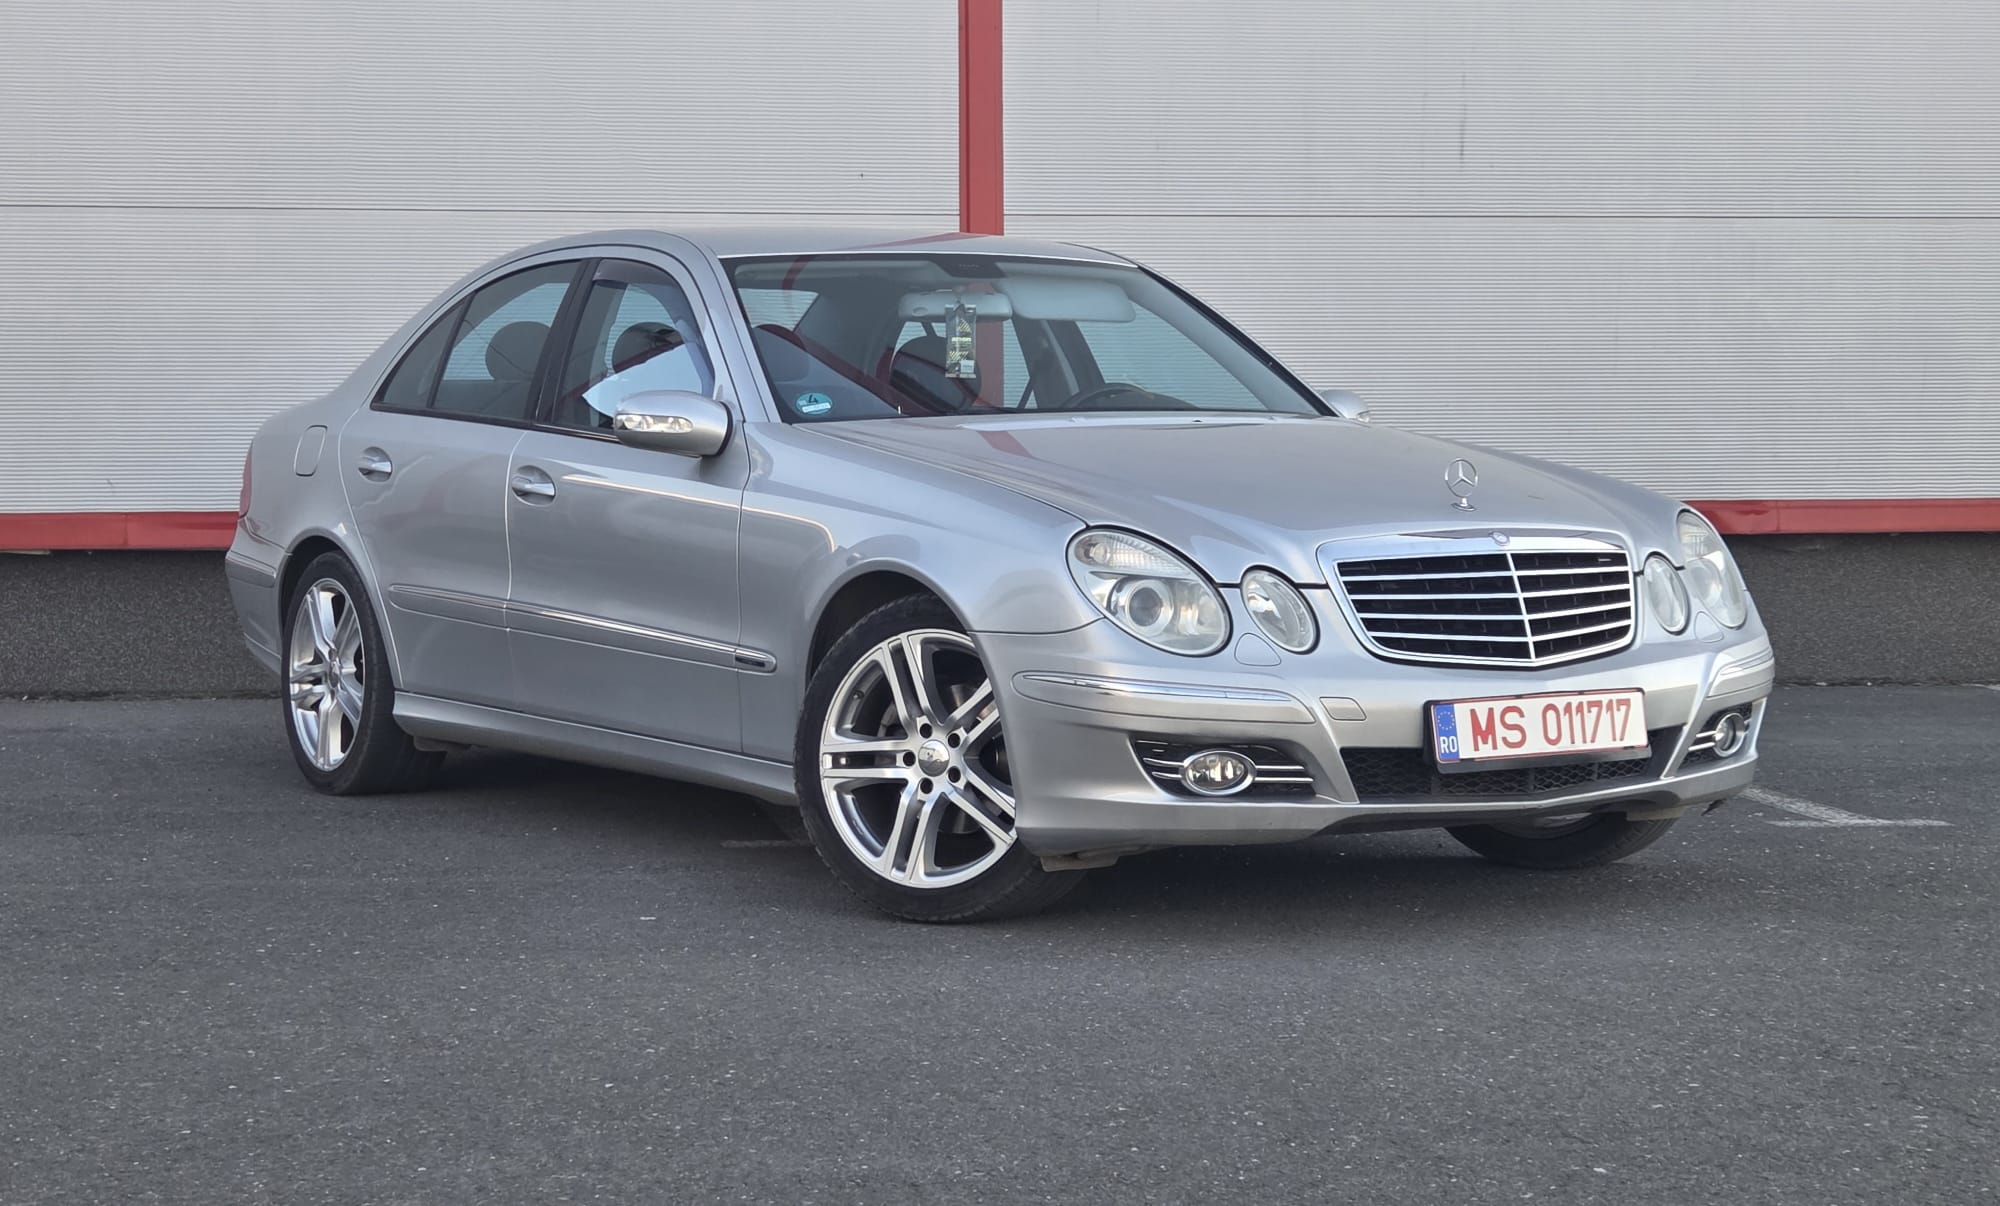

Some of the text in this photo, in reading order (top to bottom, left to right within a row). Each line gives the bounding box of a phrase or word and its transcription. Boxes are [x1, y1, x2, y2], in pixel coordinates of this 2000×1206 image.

[1469, 698, 1632, 752] MS 011717
[1440, 736, 1458, 754] RO
